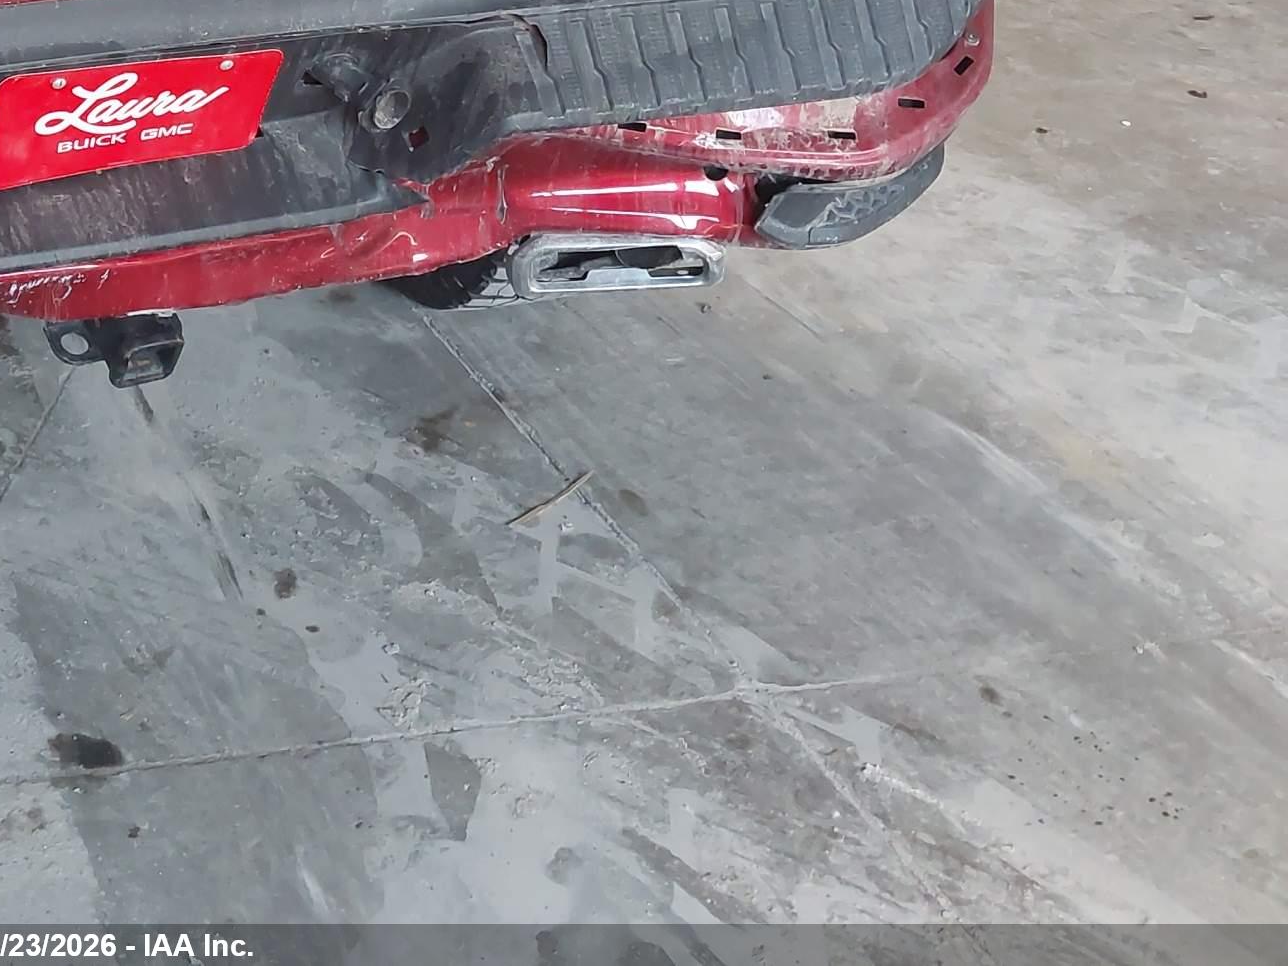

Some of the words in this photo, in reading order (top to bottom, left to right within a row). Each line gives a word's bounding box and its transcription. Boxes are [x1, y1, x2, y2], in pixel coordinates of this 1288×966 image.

[34, 72, 229, 135] Laura
[57, 133, 126, 154] BUICK
[140, 123, 194, 141] GMC
